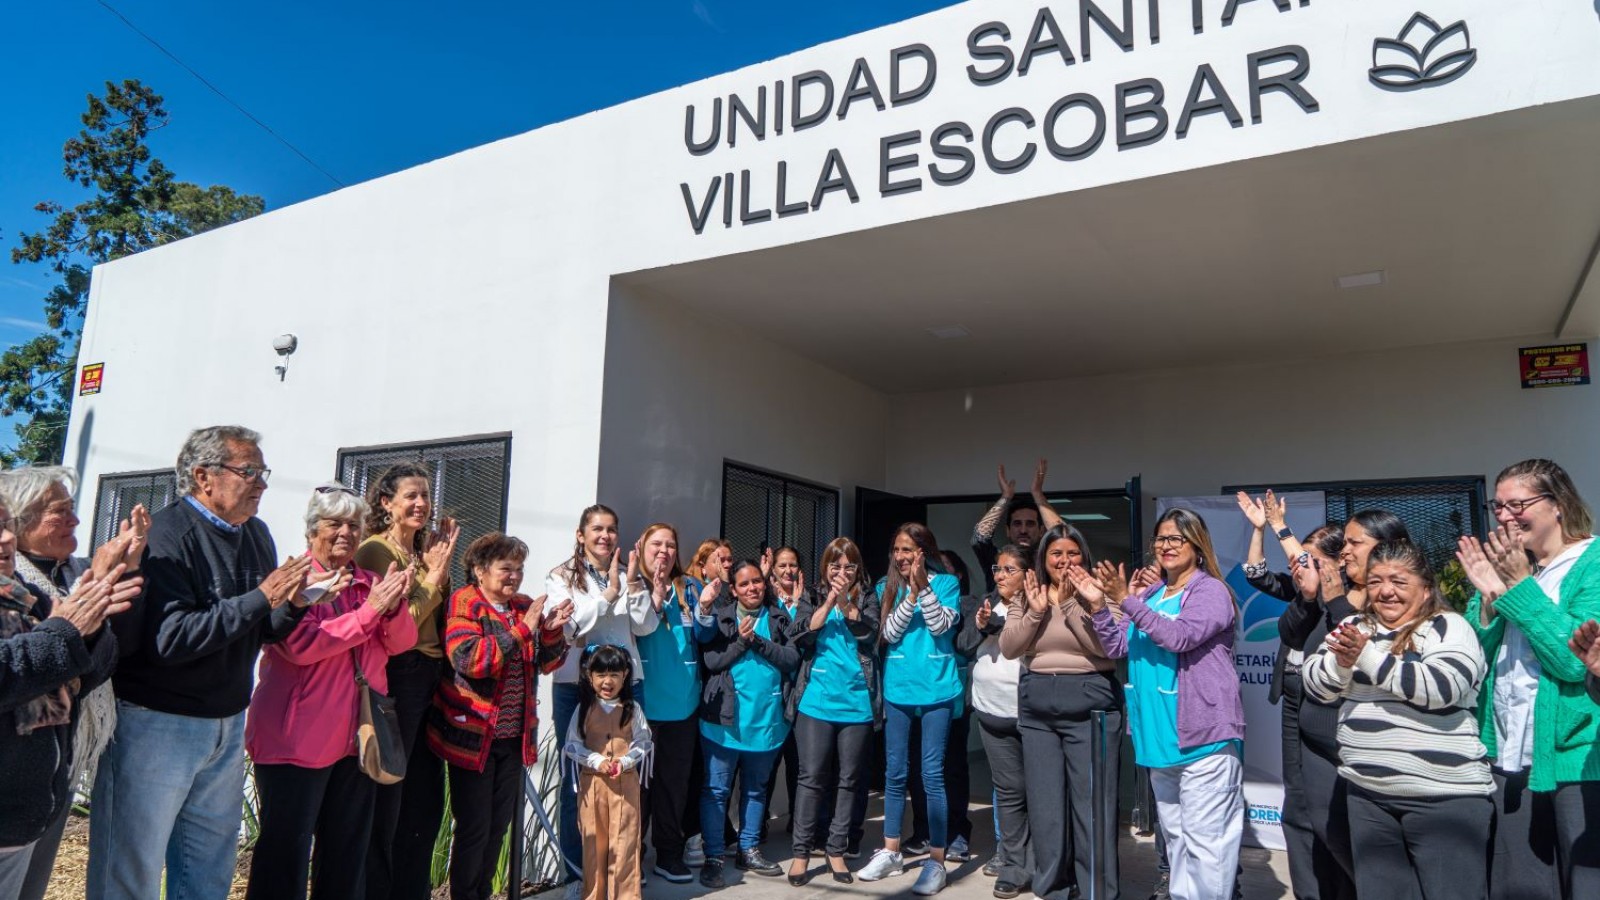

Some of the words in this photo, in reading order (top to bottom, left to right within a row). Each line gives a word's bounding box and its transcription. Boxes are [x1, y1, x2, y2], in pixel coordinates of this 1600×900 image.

[684, 42, 938, 157] UNIDAD
[966, 0, 1311, 87] SANI
[679, 147, 860, 236] VILLA
[878, 44, 1321, 199] ESCOBAR
[1233, 651, 1275, 667] ETARÍ
[1246, 808, 1284, 821] OREN
